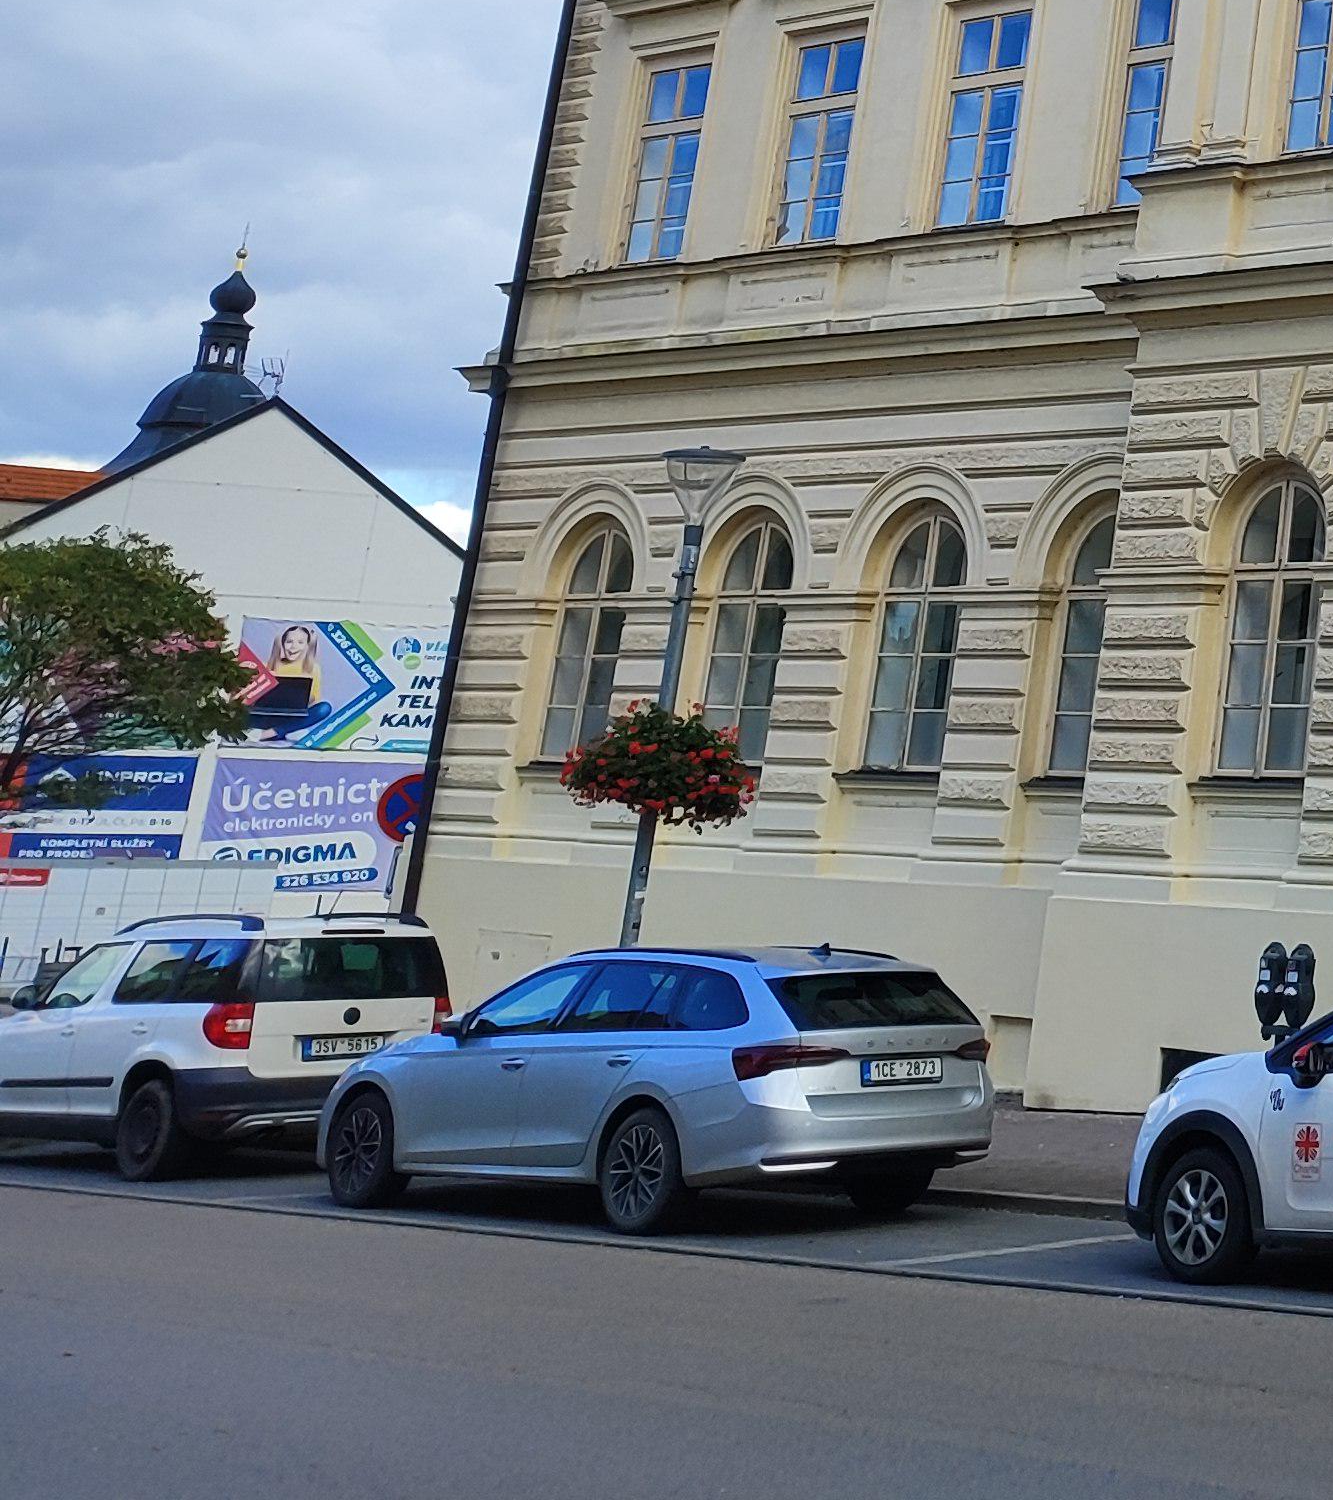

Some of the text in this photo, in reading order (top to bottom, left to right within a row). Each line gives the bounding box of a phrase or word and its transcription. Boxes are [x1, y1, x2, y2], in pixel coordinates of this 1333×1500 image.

[398, 694, 437, 709] TEL
[223, 813, 334, 833] elektronicky
[40, 838, 156, 848] KOMPLETNÍ SLUŽBY
[281, 870, 369, 888] 326 534 920
[874, 1060, 936, 1078] 1CE 2873
